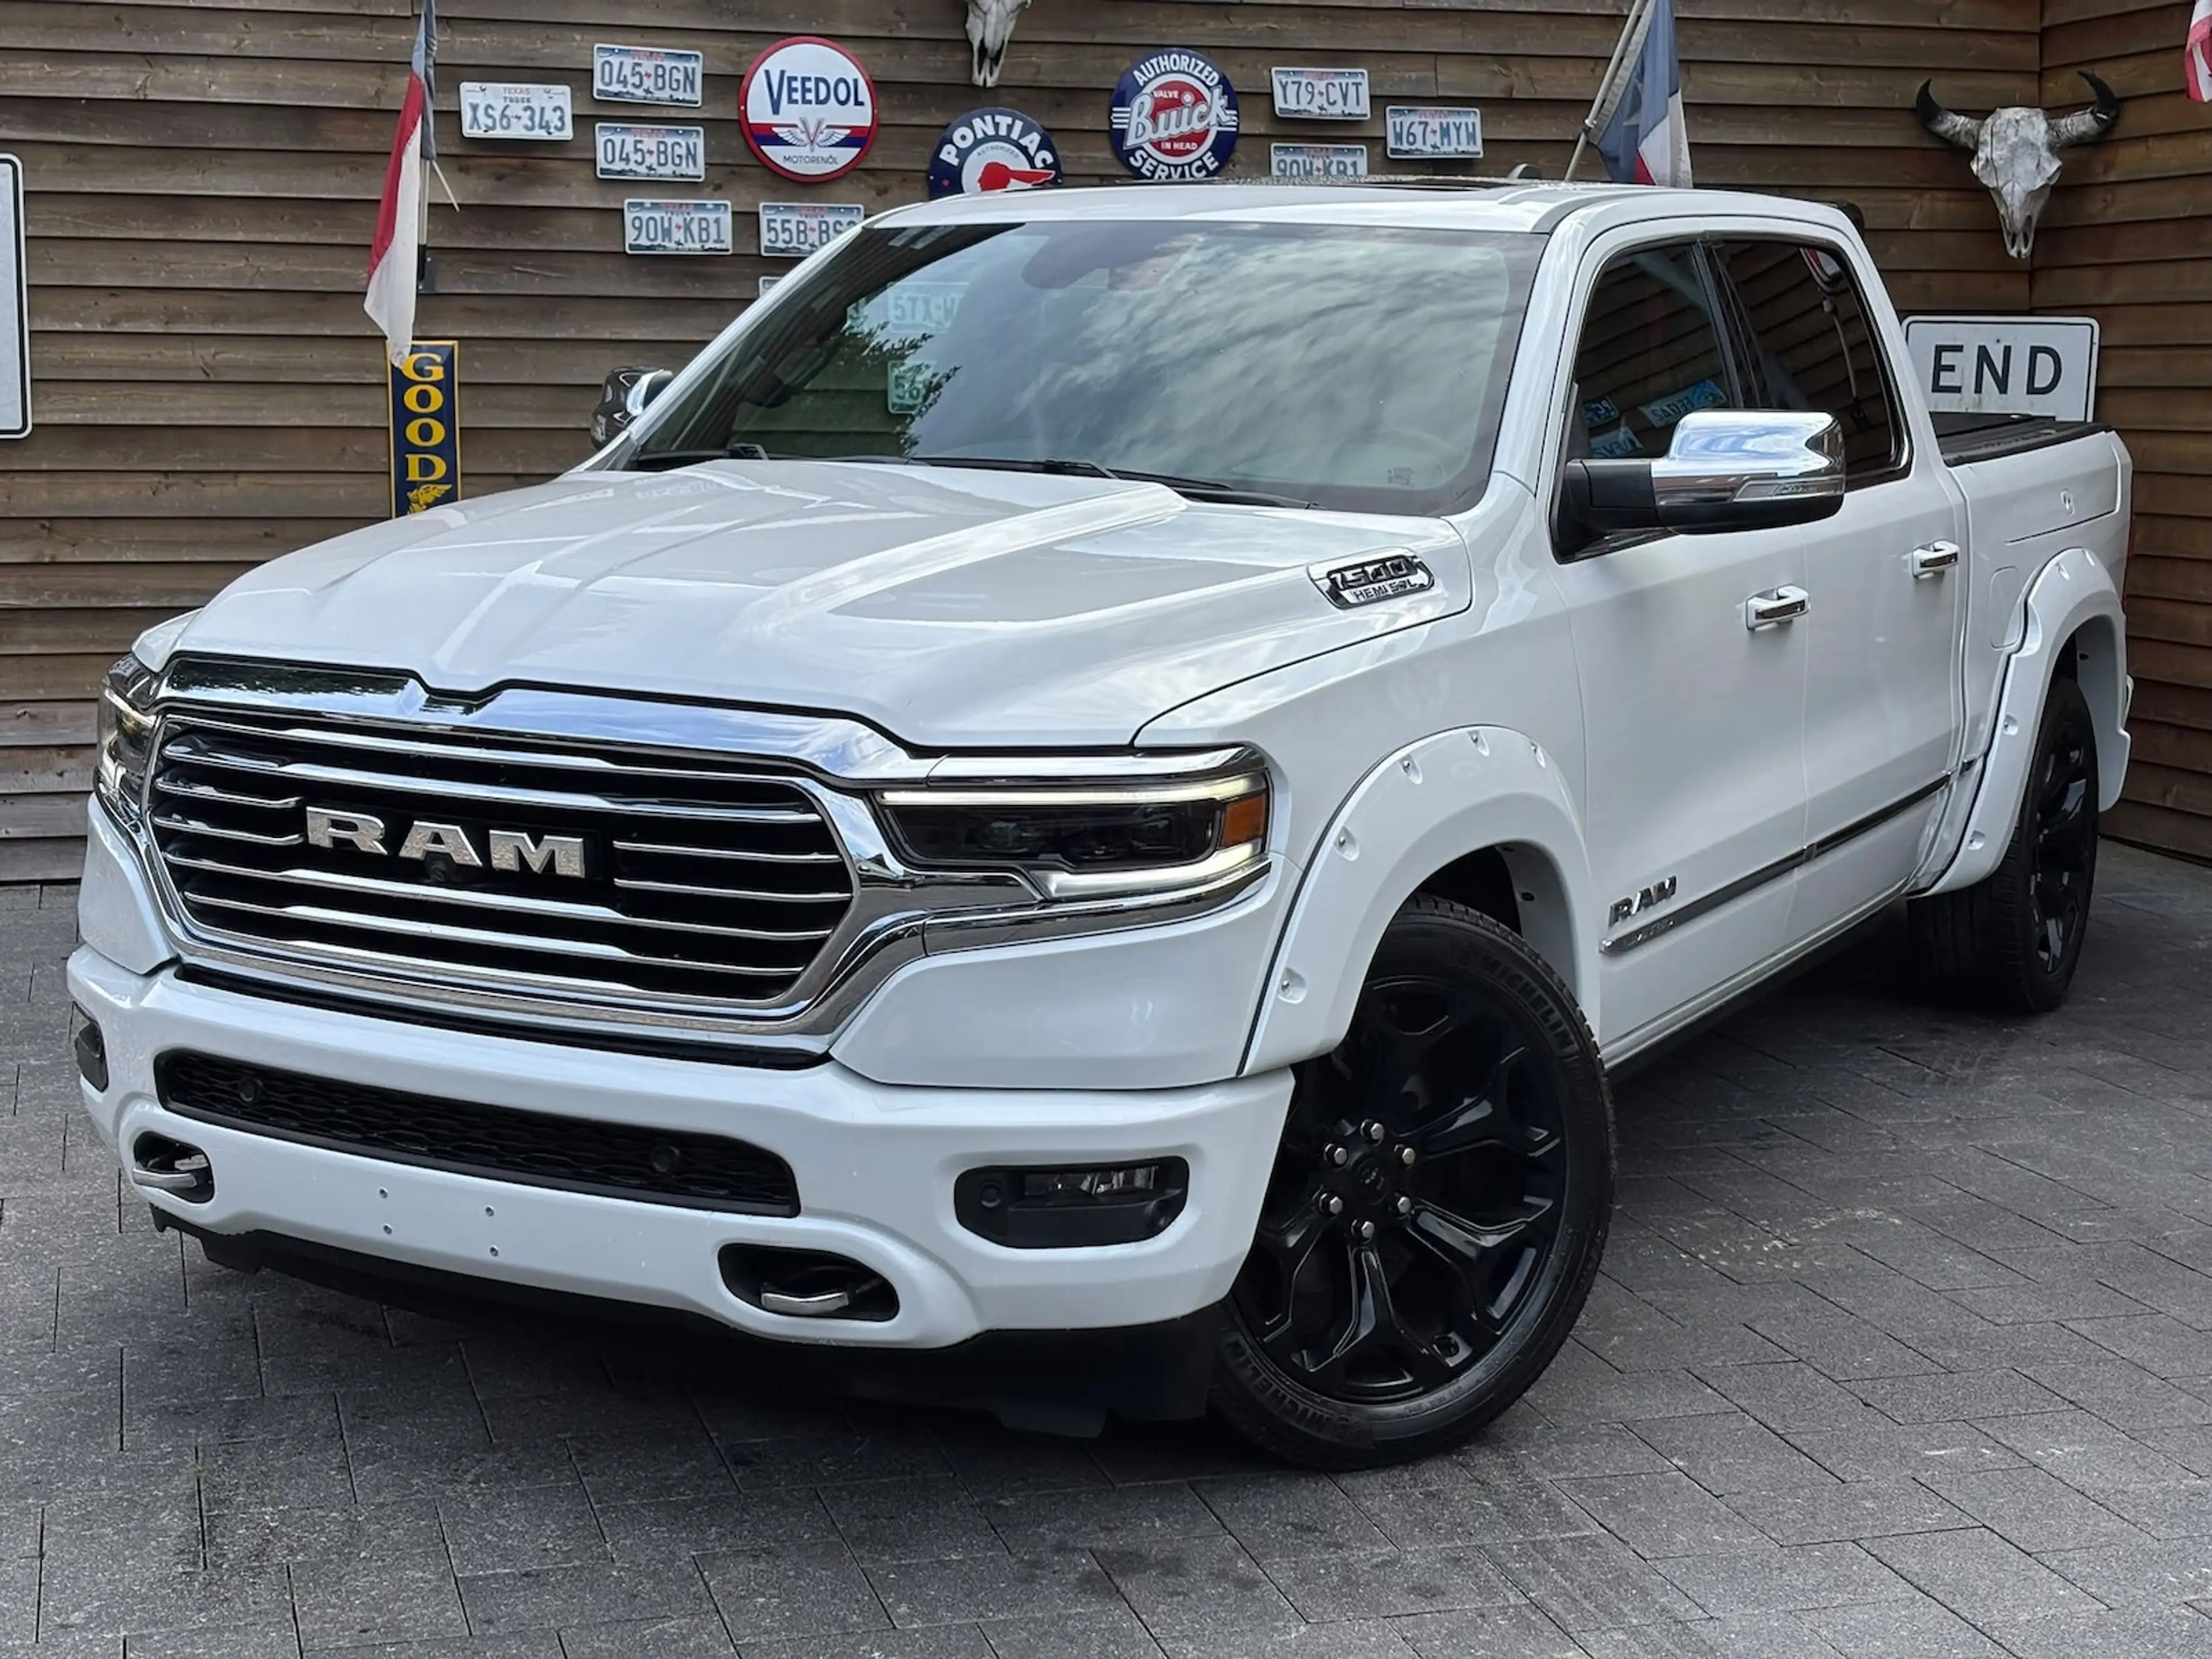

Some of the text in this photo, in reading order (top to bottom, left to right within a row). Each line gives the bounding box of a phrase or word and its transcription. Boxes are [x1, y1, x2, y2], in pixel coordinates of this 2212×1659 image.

[1132, 54, 1220, 86] AUTHORIZED
[1153, 90, 1179, 100] VALVE
[939, 115, 1054, 168] PONTIAC
[1123, 84, 1230, 150] Buick
[1128, 150, 1219, 181] SERVICE
[1161, 142, 1198, 150] IN HEAD
[1931, 344, 2062, 395] END
[401, 352, 447, 482] GOOD
[1330, 558, 1410, 590] 1500
[1353, 584, 1388, 600] HEMI
[306, 806, 586, 878] RAM
[1608, 874, 1677, 927] RAM
[1478, 954, 1575, 1050] MICHELIN
